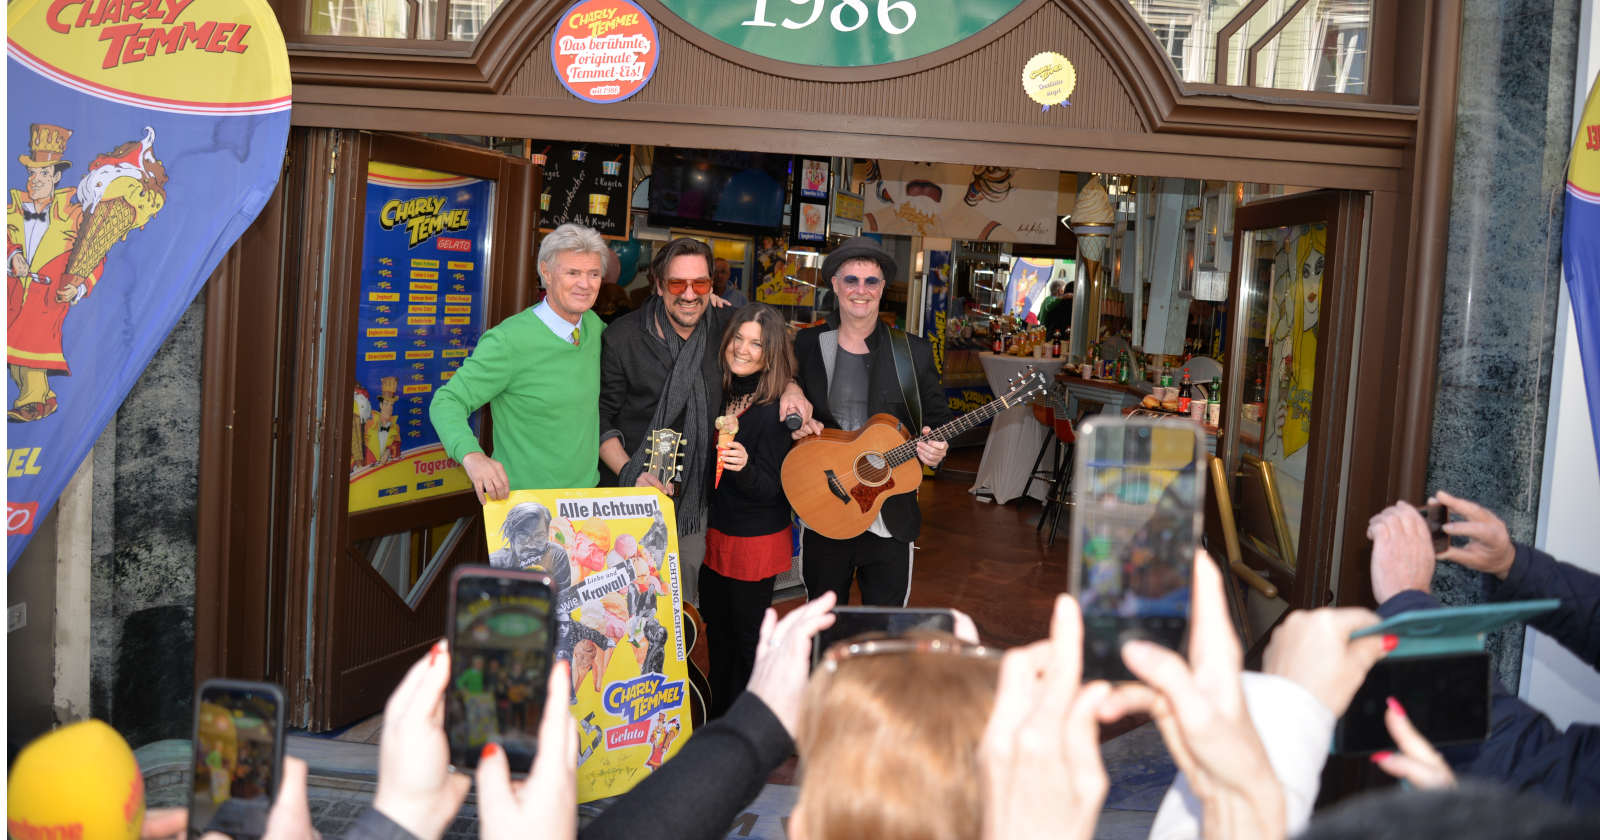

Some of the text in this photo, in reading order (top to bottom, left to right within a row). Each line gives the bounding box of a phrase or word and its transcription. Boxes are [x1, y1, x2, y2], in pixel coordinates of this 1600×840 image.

[46, 0, 195, 34] CHARLY
[569, 8, 618, 29] CHARLY
[588, 14, 639, 38] TEMMEL
[98, 21, 251, 69] TEMMEL
[563, 38, 586, 51] Das
[380, 197, 446, 228] CHARLY
[406, 209, 470, 249] TEMMEL
[438, 239, 471, 250] GELATO
[7, 447, 42, 478] EL
[559, 499, 657, 518] Alle Achtung!
[582, 575, 627, 602] Krawall
[609, 680, 660, 708] CHARLY
[630, 687, 680, 721] TEMMEL
[611, 728, 645, 745] Gelato
